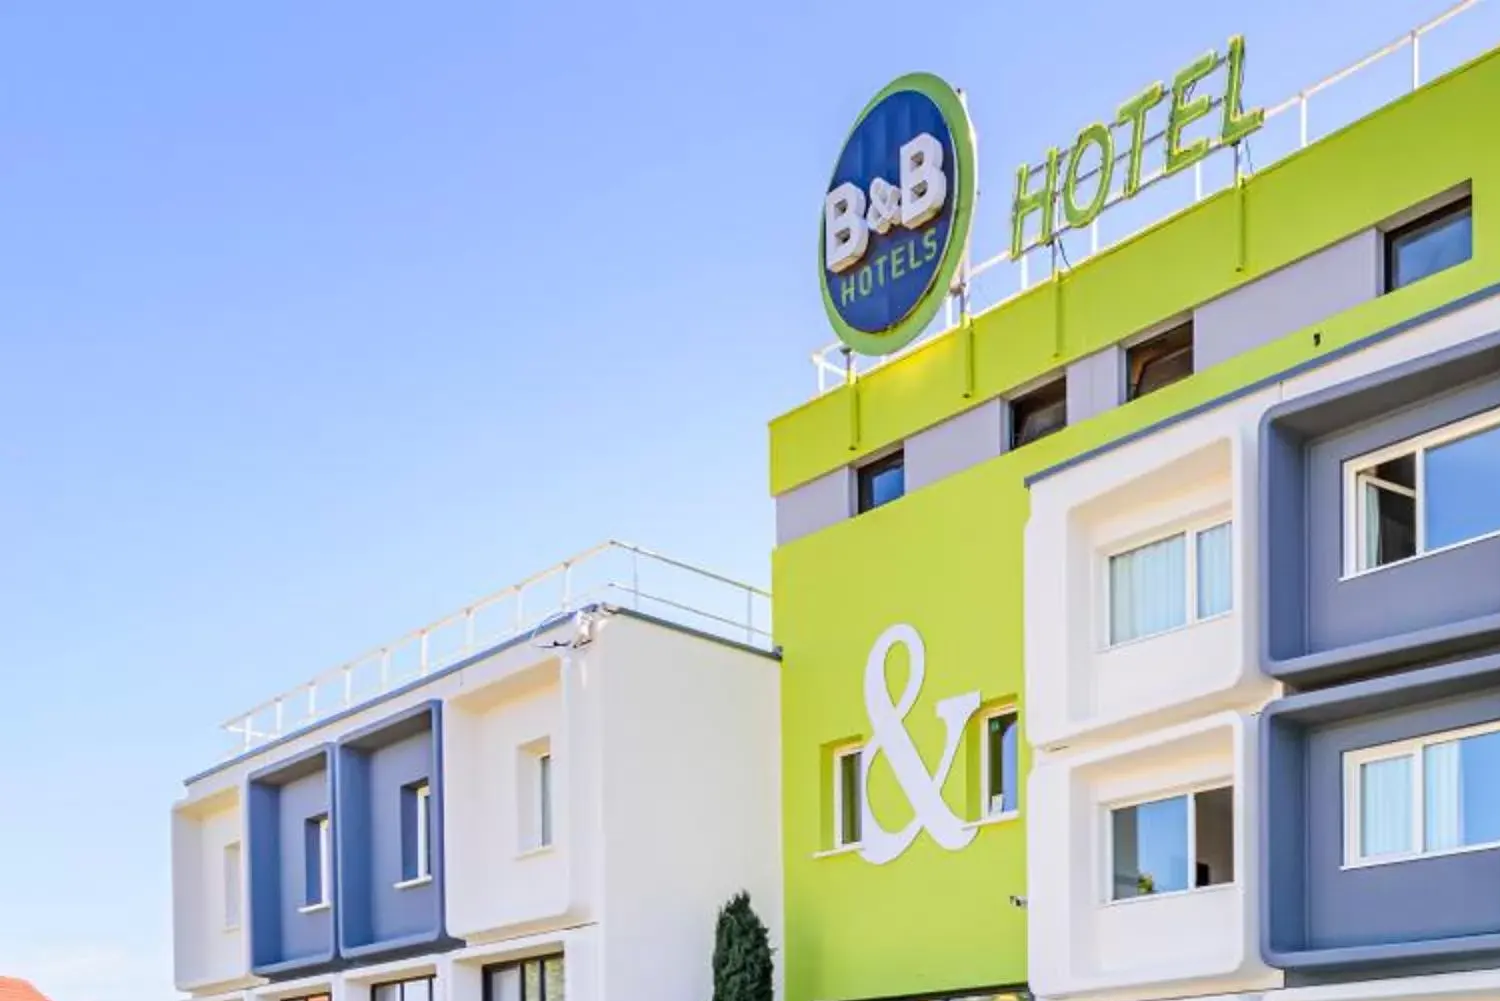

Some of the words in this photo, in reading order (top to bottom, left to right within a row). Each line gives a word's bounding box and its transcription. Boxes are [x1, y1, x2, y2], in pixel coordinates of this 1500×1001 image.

[825, 132, 946, 272] B&B
[1011, 34, 1264, 259] HOTEL
[840, 227, 937, 306] HOTELS
[859, 623, 981, 864] &
